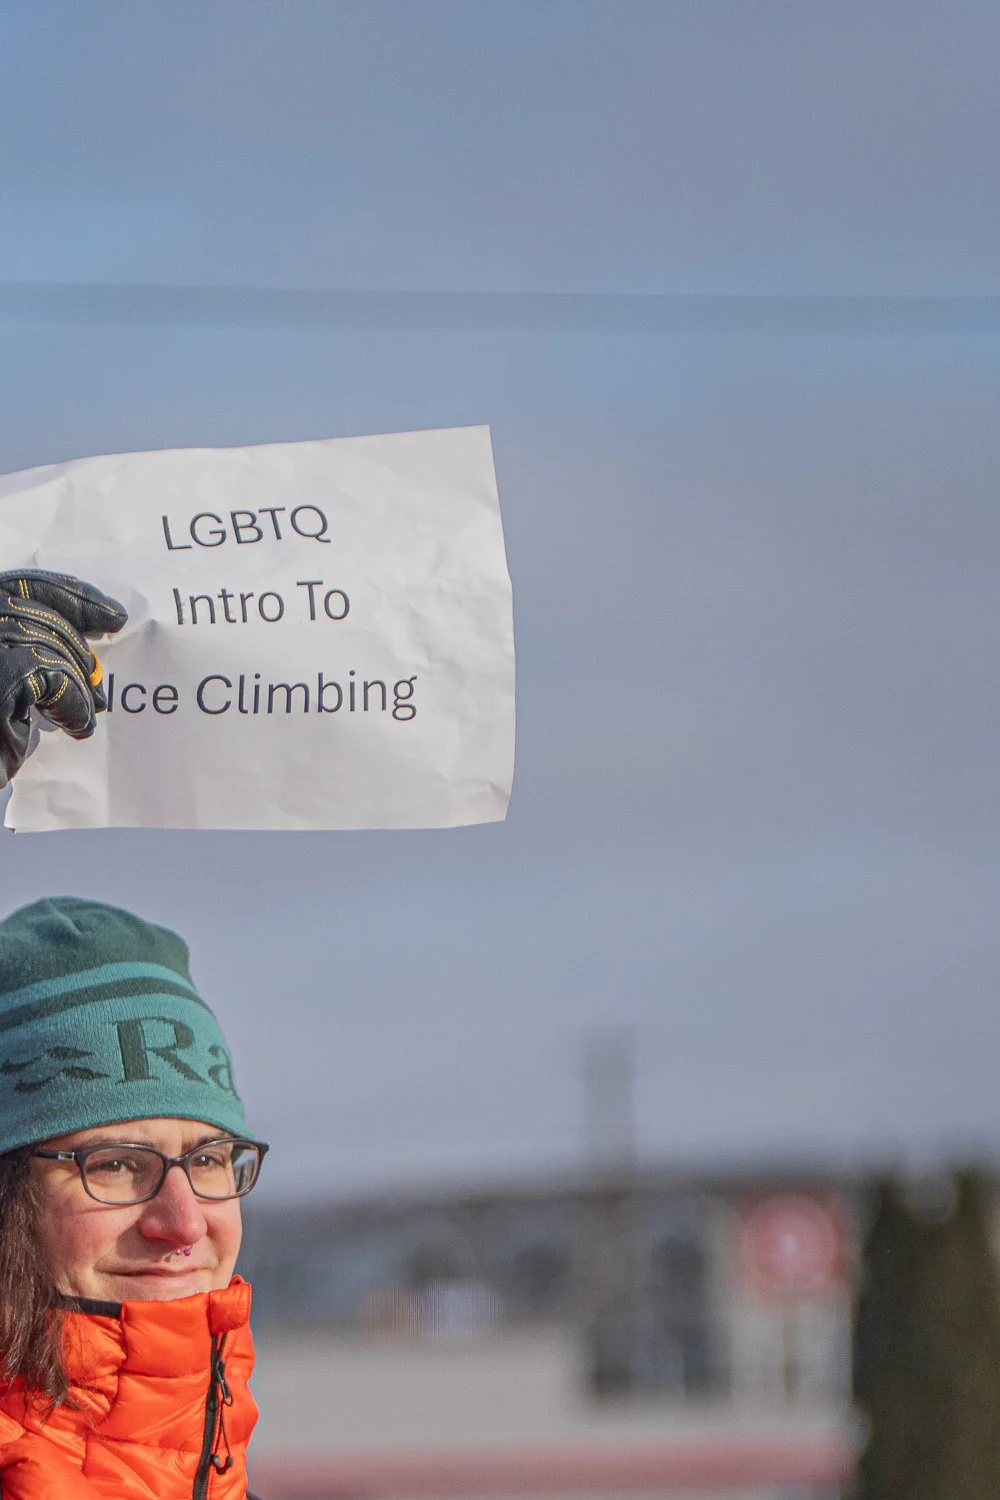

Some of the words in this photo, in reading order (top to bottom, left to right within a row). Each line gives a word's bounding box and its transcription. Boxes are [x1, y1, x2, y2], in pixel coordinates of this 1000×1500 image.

[162, 504, 332, 551] LGBTQ
[172, 587, 285, 626] Intro
[296, 580, 350, 621] To
[106, 673, 179, 715] Ice
[196, 669, 418, 722] Climbing
